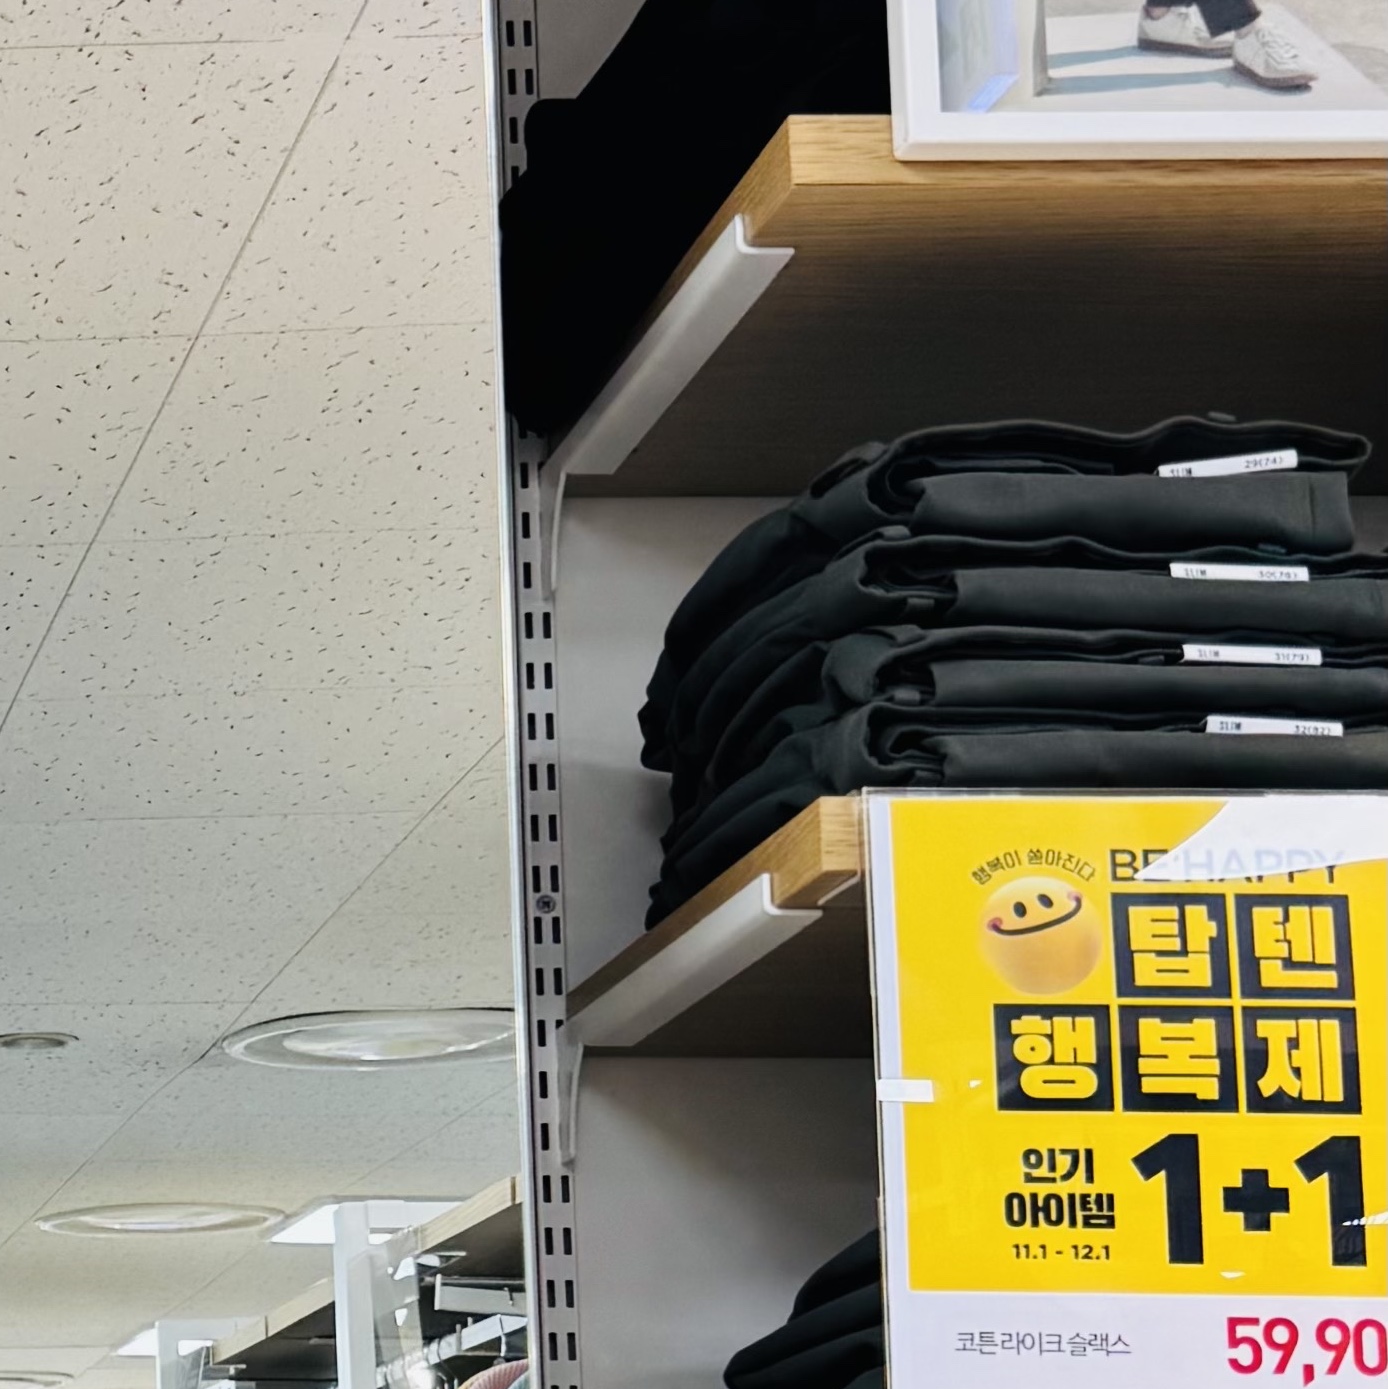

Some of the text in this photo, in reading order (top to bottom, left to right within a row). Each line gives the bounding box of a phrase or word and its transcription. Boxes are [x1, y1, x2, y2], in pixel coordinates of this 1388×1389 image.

[971, 849, 1023, 886] 행복이
[1127, 903, 1339, 990] 탑텐
[1010, 1014, 1346, 1103] 행복제
[1022, 1147, 1095, 1185] 인기
[1004, 1191, 1116, 1230] 아이템
[1131, 1132, 1369, 1268] 1+1
[1012, 1243, 1047, 1260] 11.1
[1071, 1244, 1110, 1260] 12.1
[1227, 1316, 1388, 1388] 59,90
